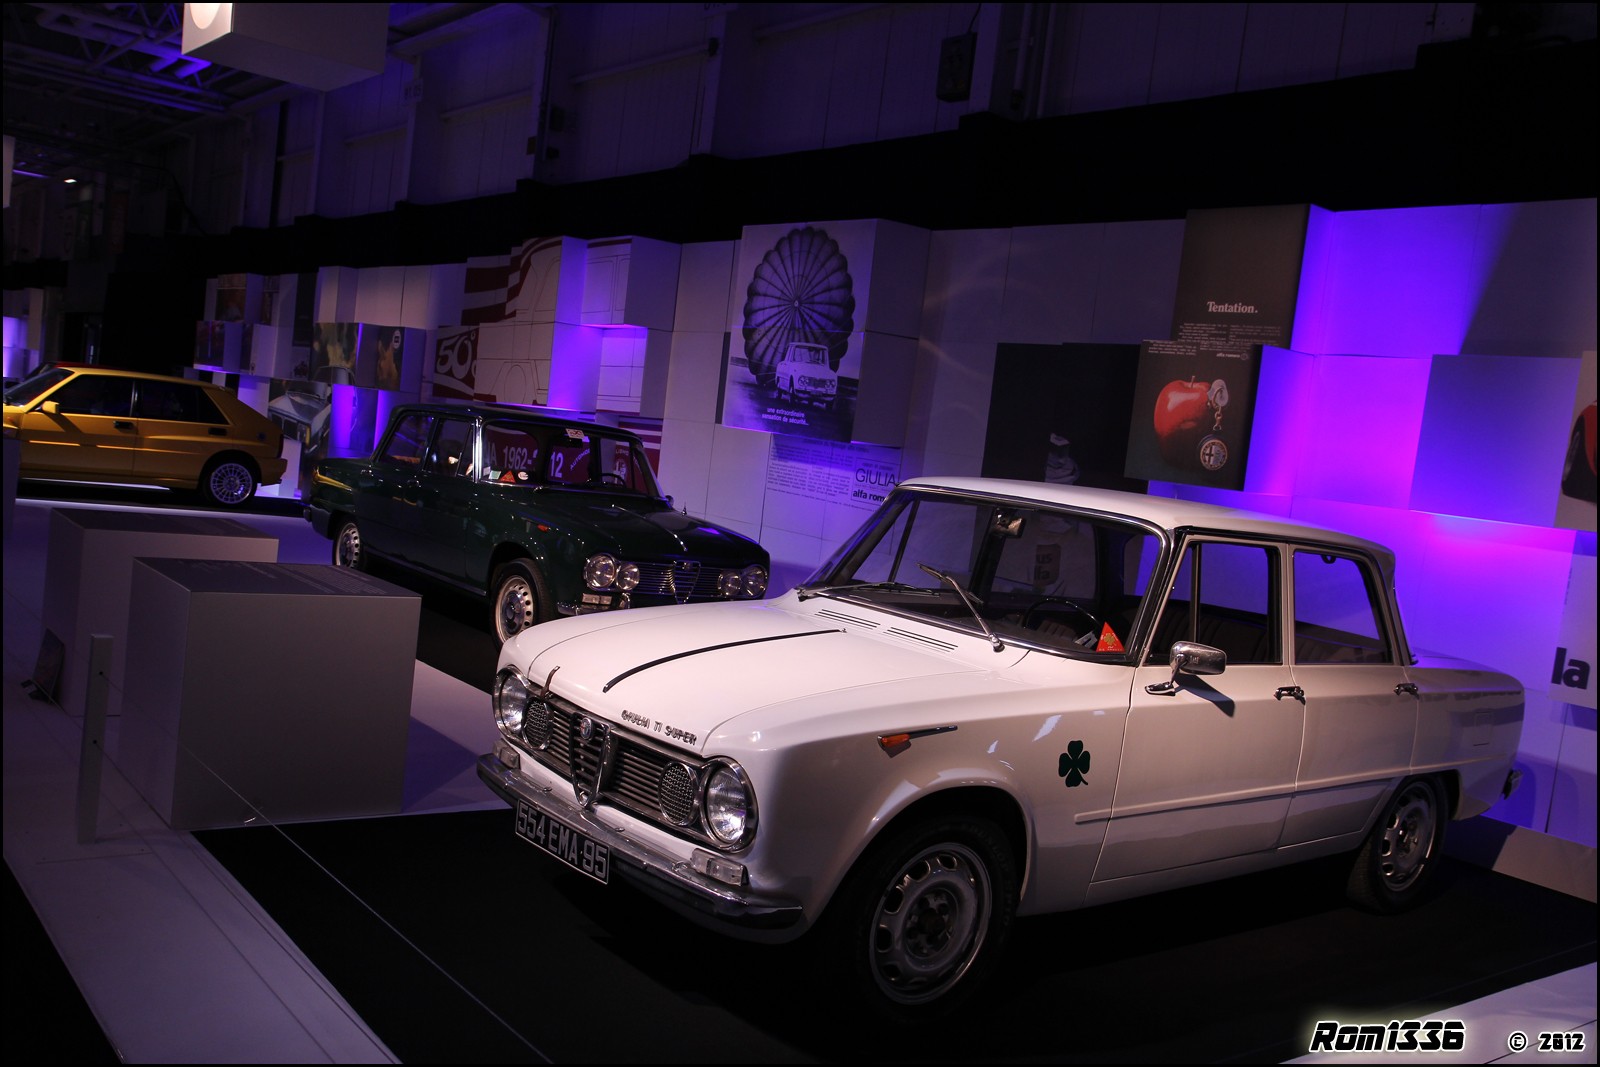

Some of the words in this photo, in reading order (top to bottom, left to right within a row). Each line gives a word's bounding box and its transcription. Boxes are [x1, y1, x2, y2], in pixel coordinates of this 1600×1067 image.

[1206, 301, 1259, 314] Tentation.
[776, 409, 805, 418] extraordinaire
[855, 468, 896, 487] GIULIA
[853, 489, 868, 499] alfa
[869, 493, 885, 502] rom
[1551, 646, 1591, 690] la
[621, 709, 651, 729] GIULIA
[653, 721, 663, 732] TI
[665, 725, 697, 746] SUPER
[517, 801, 547, 845] 554
[547, 819, 579, 865] EMA
[582, 839, 609, 879] 95
